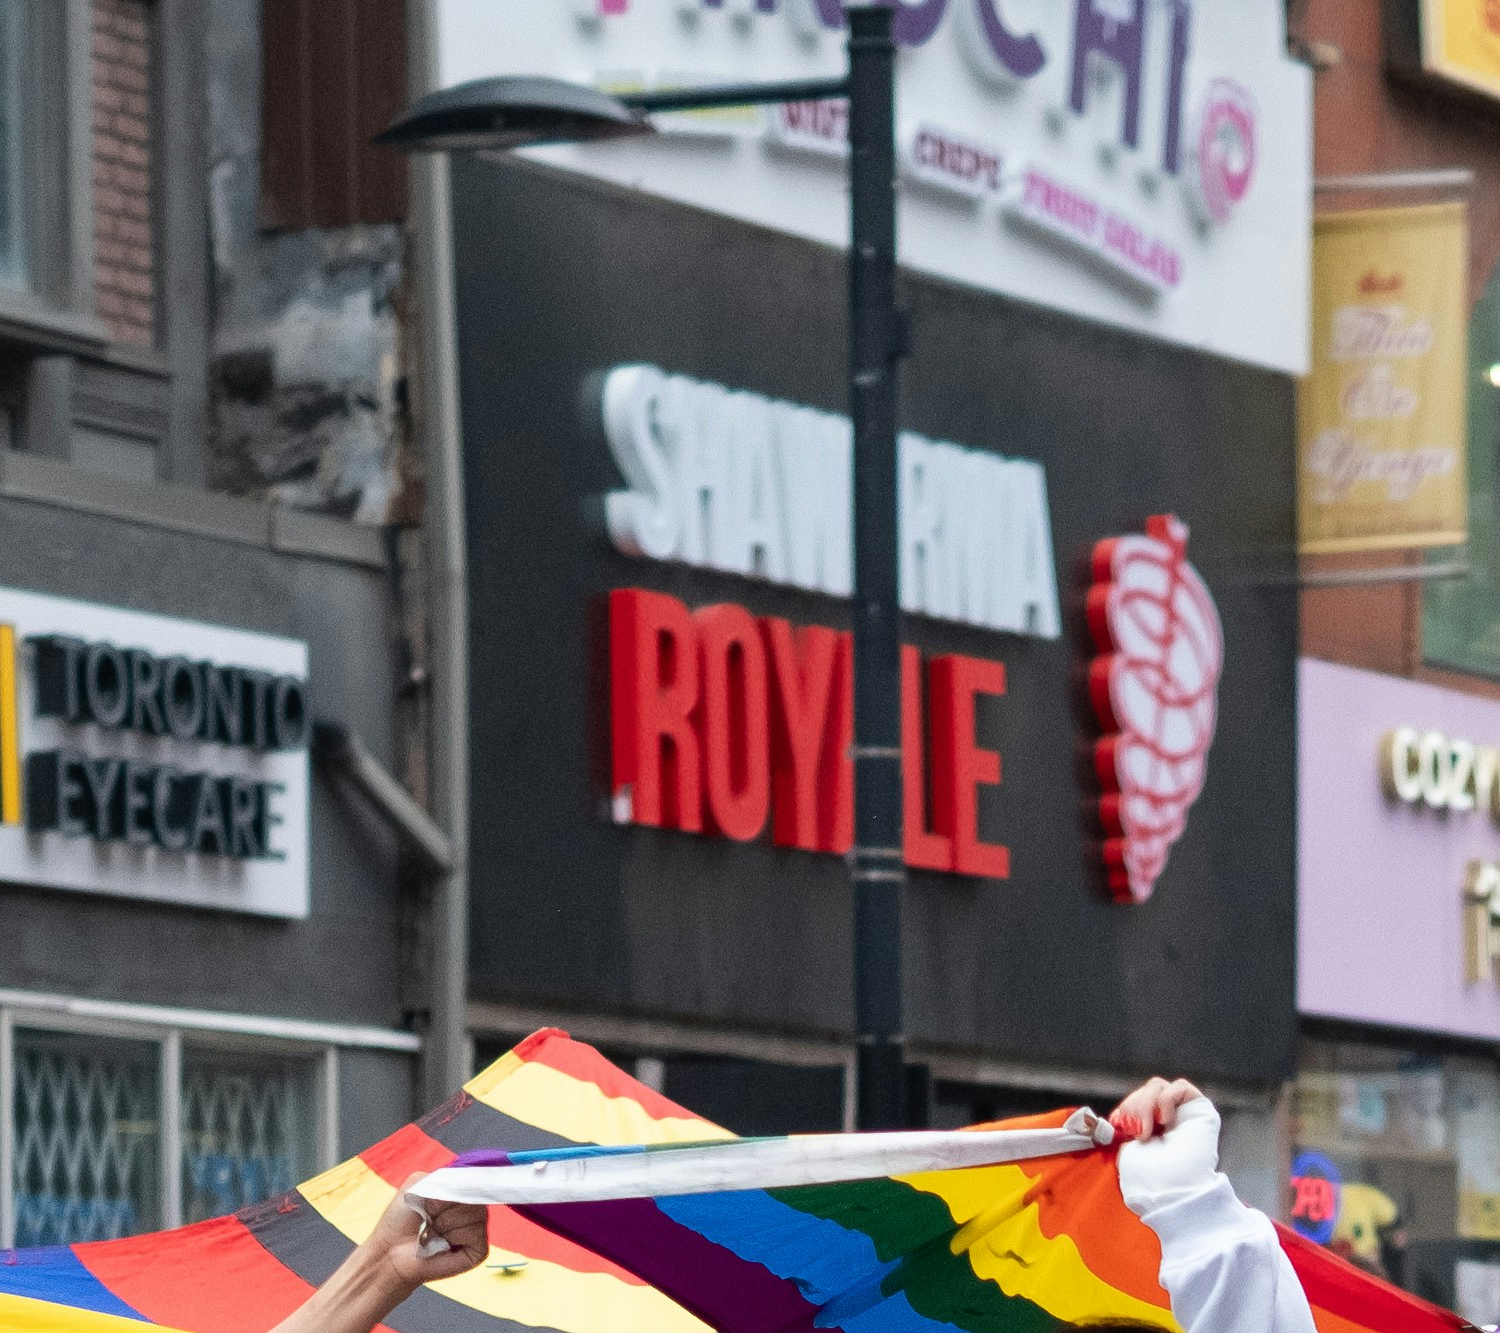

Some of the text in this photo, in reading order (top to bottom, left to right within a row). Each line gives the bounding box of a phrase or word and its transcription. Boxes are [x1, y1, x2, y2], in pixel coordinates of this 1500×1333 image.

[604, 362, 1061, 640] SHAWRMA
[26, 634, 308, 751] TORONTO
[609, 588, 1011, 879] ROYLE
[28, 749, 287, 862] EYECARE
[1380, 727, 1499, 812] COZY
